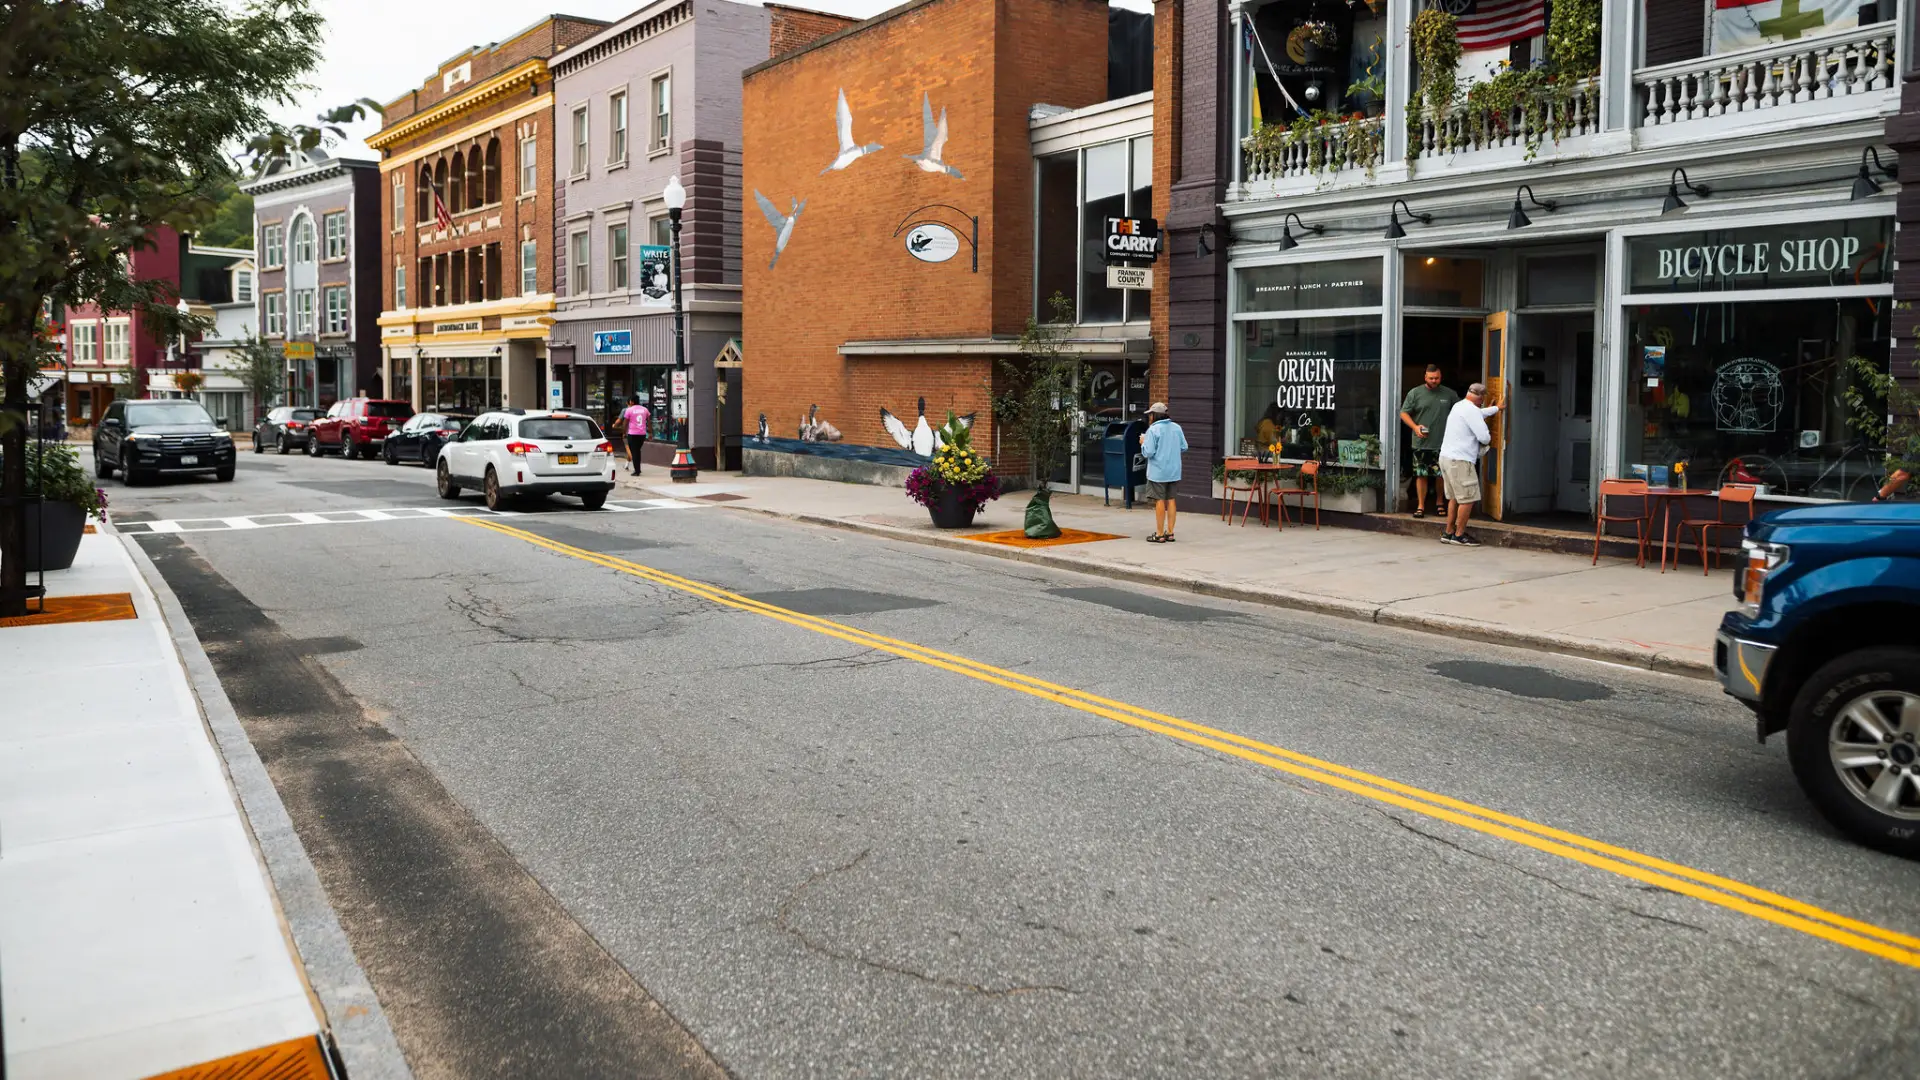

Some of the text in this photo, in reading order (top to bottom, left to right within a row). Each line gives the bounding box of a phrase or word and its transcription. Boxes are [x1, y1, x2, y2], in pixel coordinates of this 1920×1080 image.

[1108, 217, 1141, 235] THE
[1107, 234, 1158, 252] CARRY
[643, 249, 669, 259] WRITE
[1657, 236, 1860, 279] BICYCLE SHOP
[1117, 269, 1146, 277] FRANKLIN
[1117, 276, 1145, 284] COUNTY
[1331, 280, 1364, 288] PASTRIES
[1278, 358, 1336, 383] ORIGIN
[1276, 384, 1336, 411] COFFEE
[636, 414, 643, 427] 9
[1297, 412, 1313, 428] Co.
